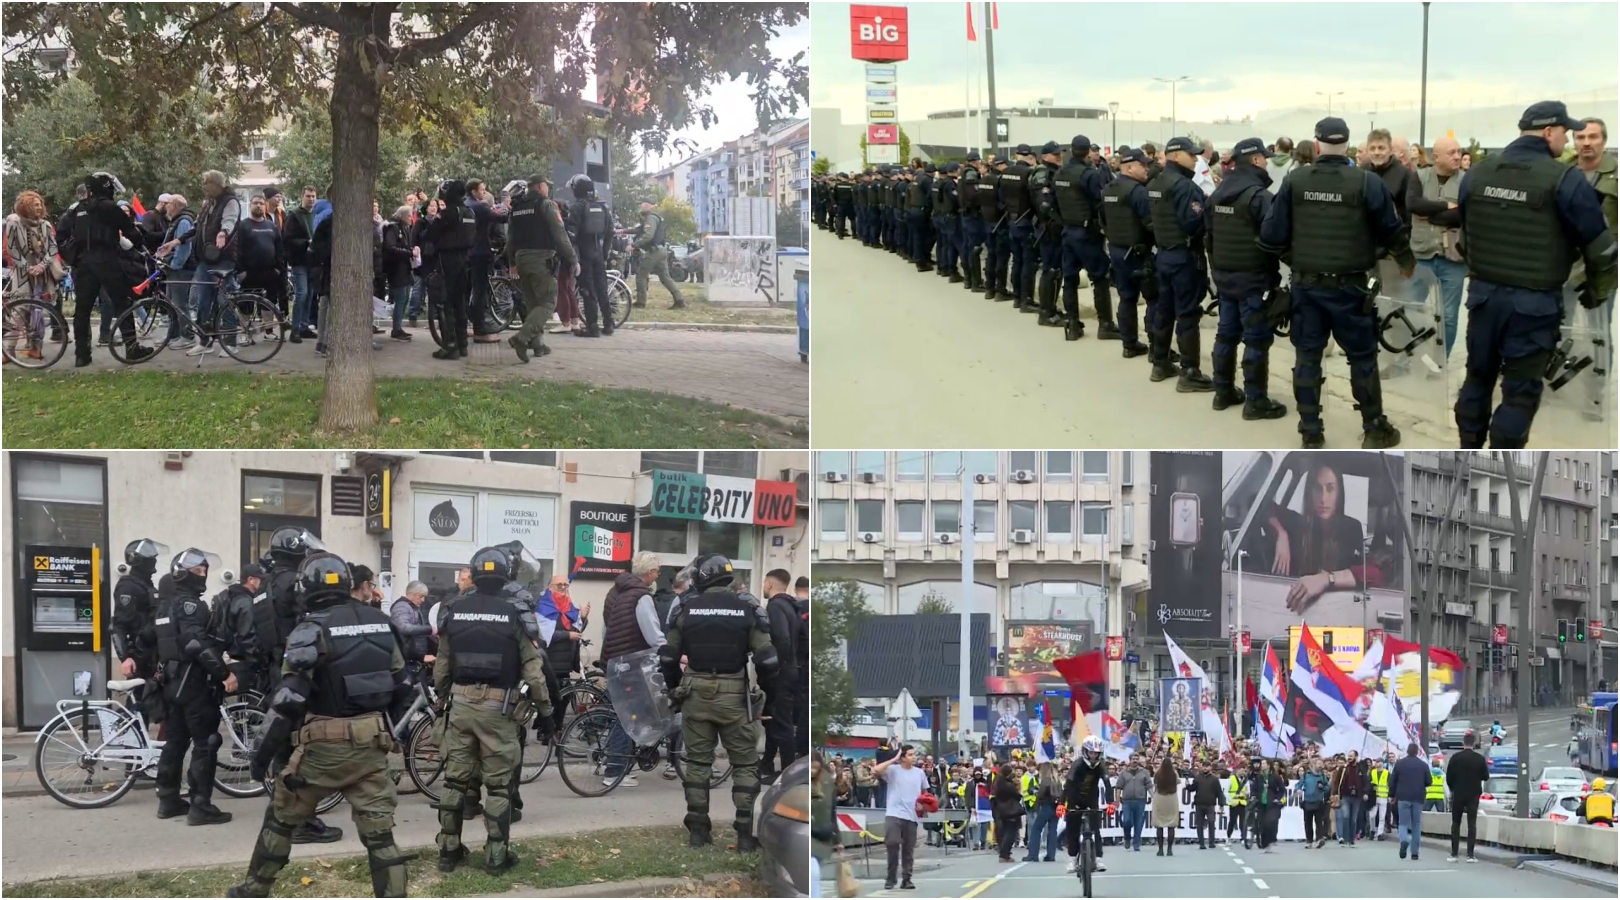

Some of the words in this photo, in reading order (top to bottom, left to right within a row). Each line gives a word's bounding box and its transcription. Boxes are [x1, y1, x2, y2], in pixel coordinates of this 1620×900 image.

[1304, 191, 1343, 202] ПОЛИЦИЈА
[1483, 186, 1528, 202] ПОЛИЦИЈА
[660, 471, 687, 482] butik
[654, 482, 753, 519] CELEBRITY
[757, 491, 793, 522] UNO
[504, 509, 538, 518] FRIZERSKO
[580, 510, 628, 523] BOUTIQUE
[431, 518, 459, 529] SALON
[581, 530, 625, 550] Celebrity
[594, 545, 612, 556] uno
[49, 556, 91, 565] Raiffeisen
[50, 563, 76, 571] BANK
[453, 612, 510, 623] ЖАНДАРМЕРИЈА
[689, 608, 745, 617] ЖАНДАРМЕРИЈА
[1172, 608, 1201, 617] ABSOLUT
[1043, 631, 1083, 641] STEAKHOUSE
